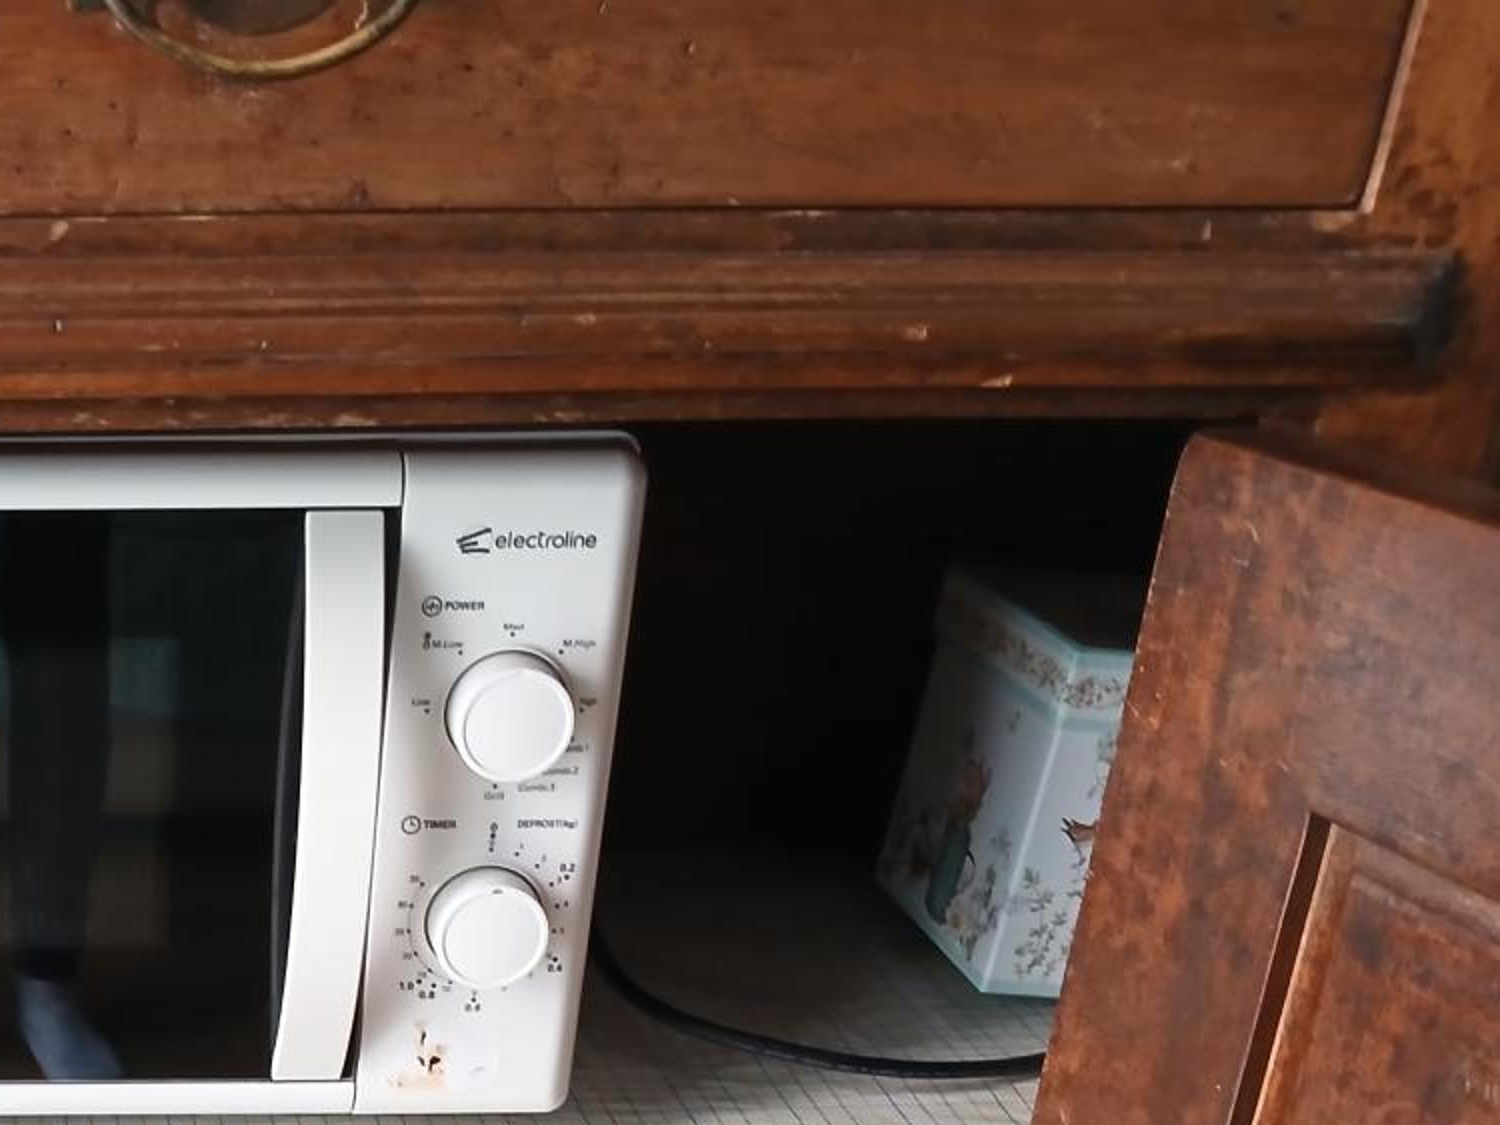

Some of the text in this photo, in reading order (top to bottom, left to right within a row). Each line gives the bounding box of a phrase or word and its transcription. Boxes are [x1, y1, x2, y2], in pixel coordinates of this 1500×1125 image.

[495, 531, 597, 549] electroline
[444, 601, 485, 611] POWER
[423, 820, 457, 829] TIMER
